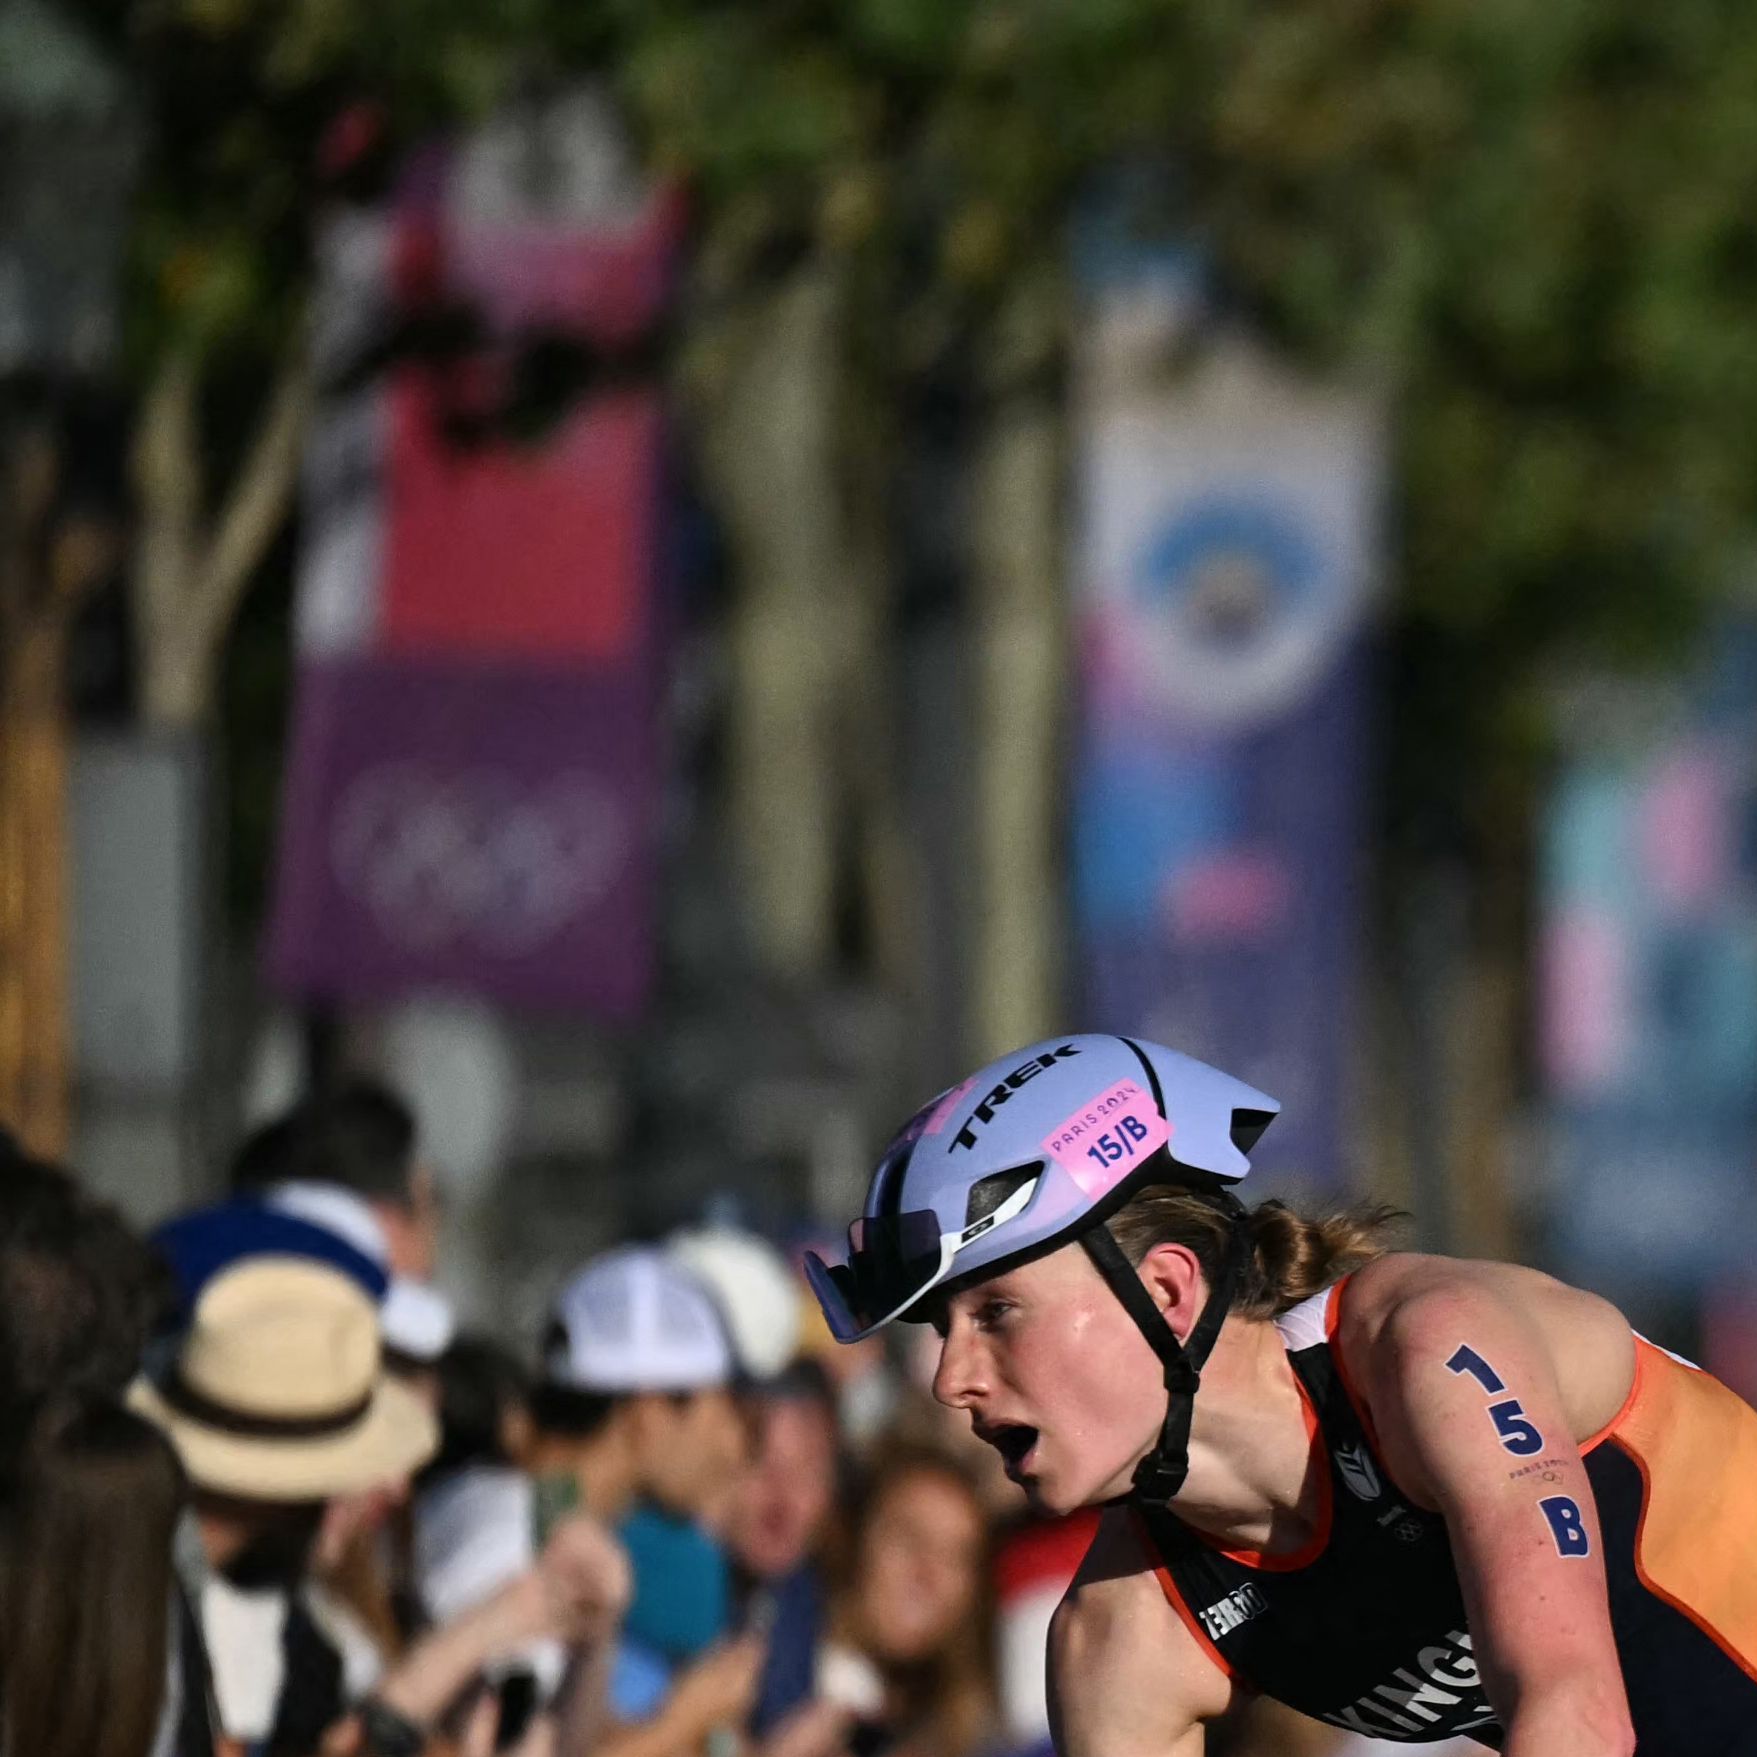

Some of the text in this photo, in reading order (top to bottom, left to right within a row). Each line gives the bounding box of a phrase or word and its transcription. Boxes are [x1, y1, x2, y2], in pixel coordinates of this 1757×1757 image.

[948, 1043, 1081, 1154] TREK
[1051, 1085, 1138, 1153] PARIS 2024
[1087, 1115, 1148, 1169] 15/B
[1538, 1494, 1590, 1559] B
